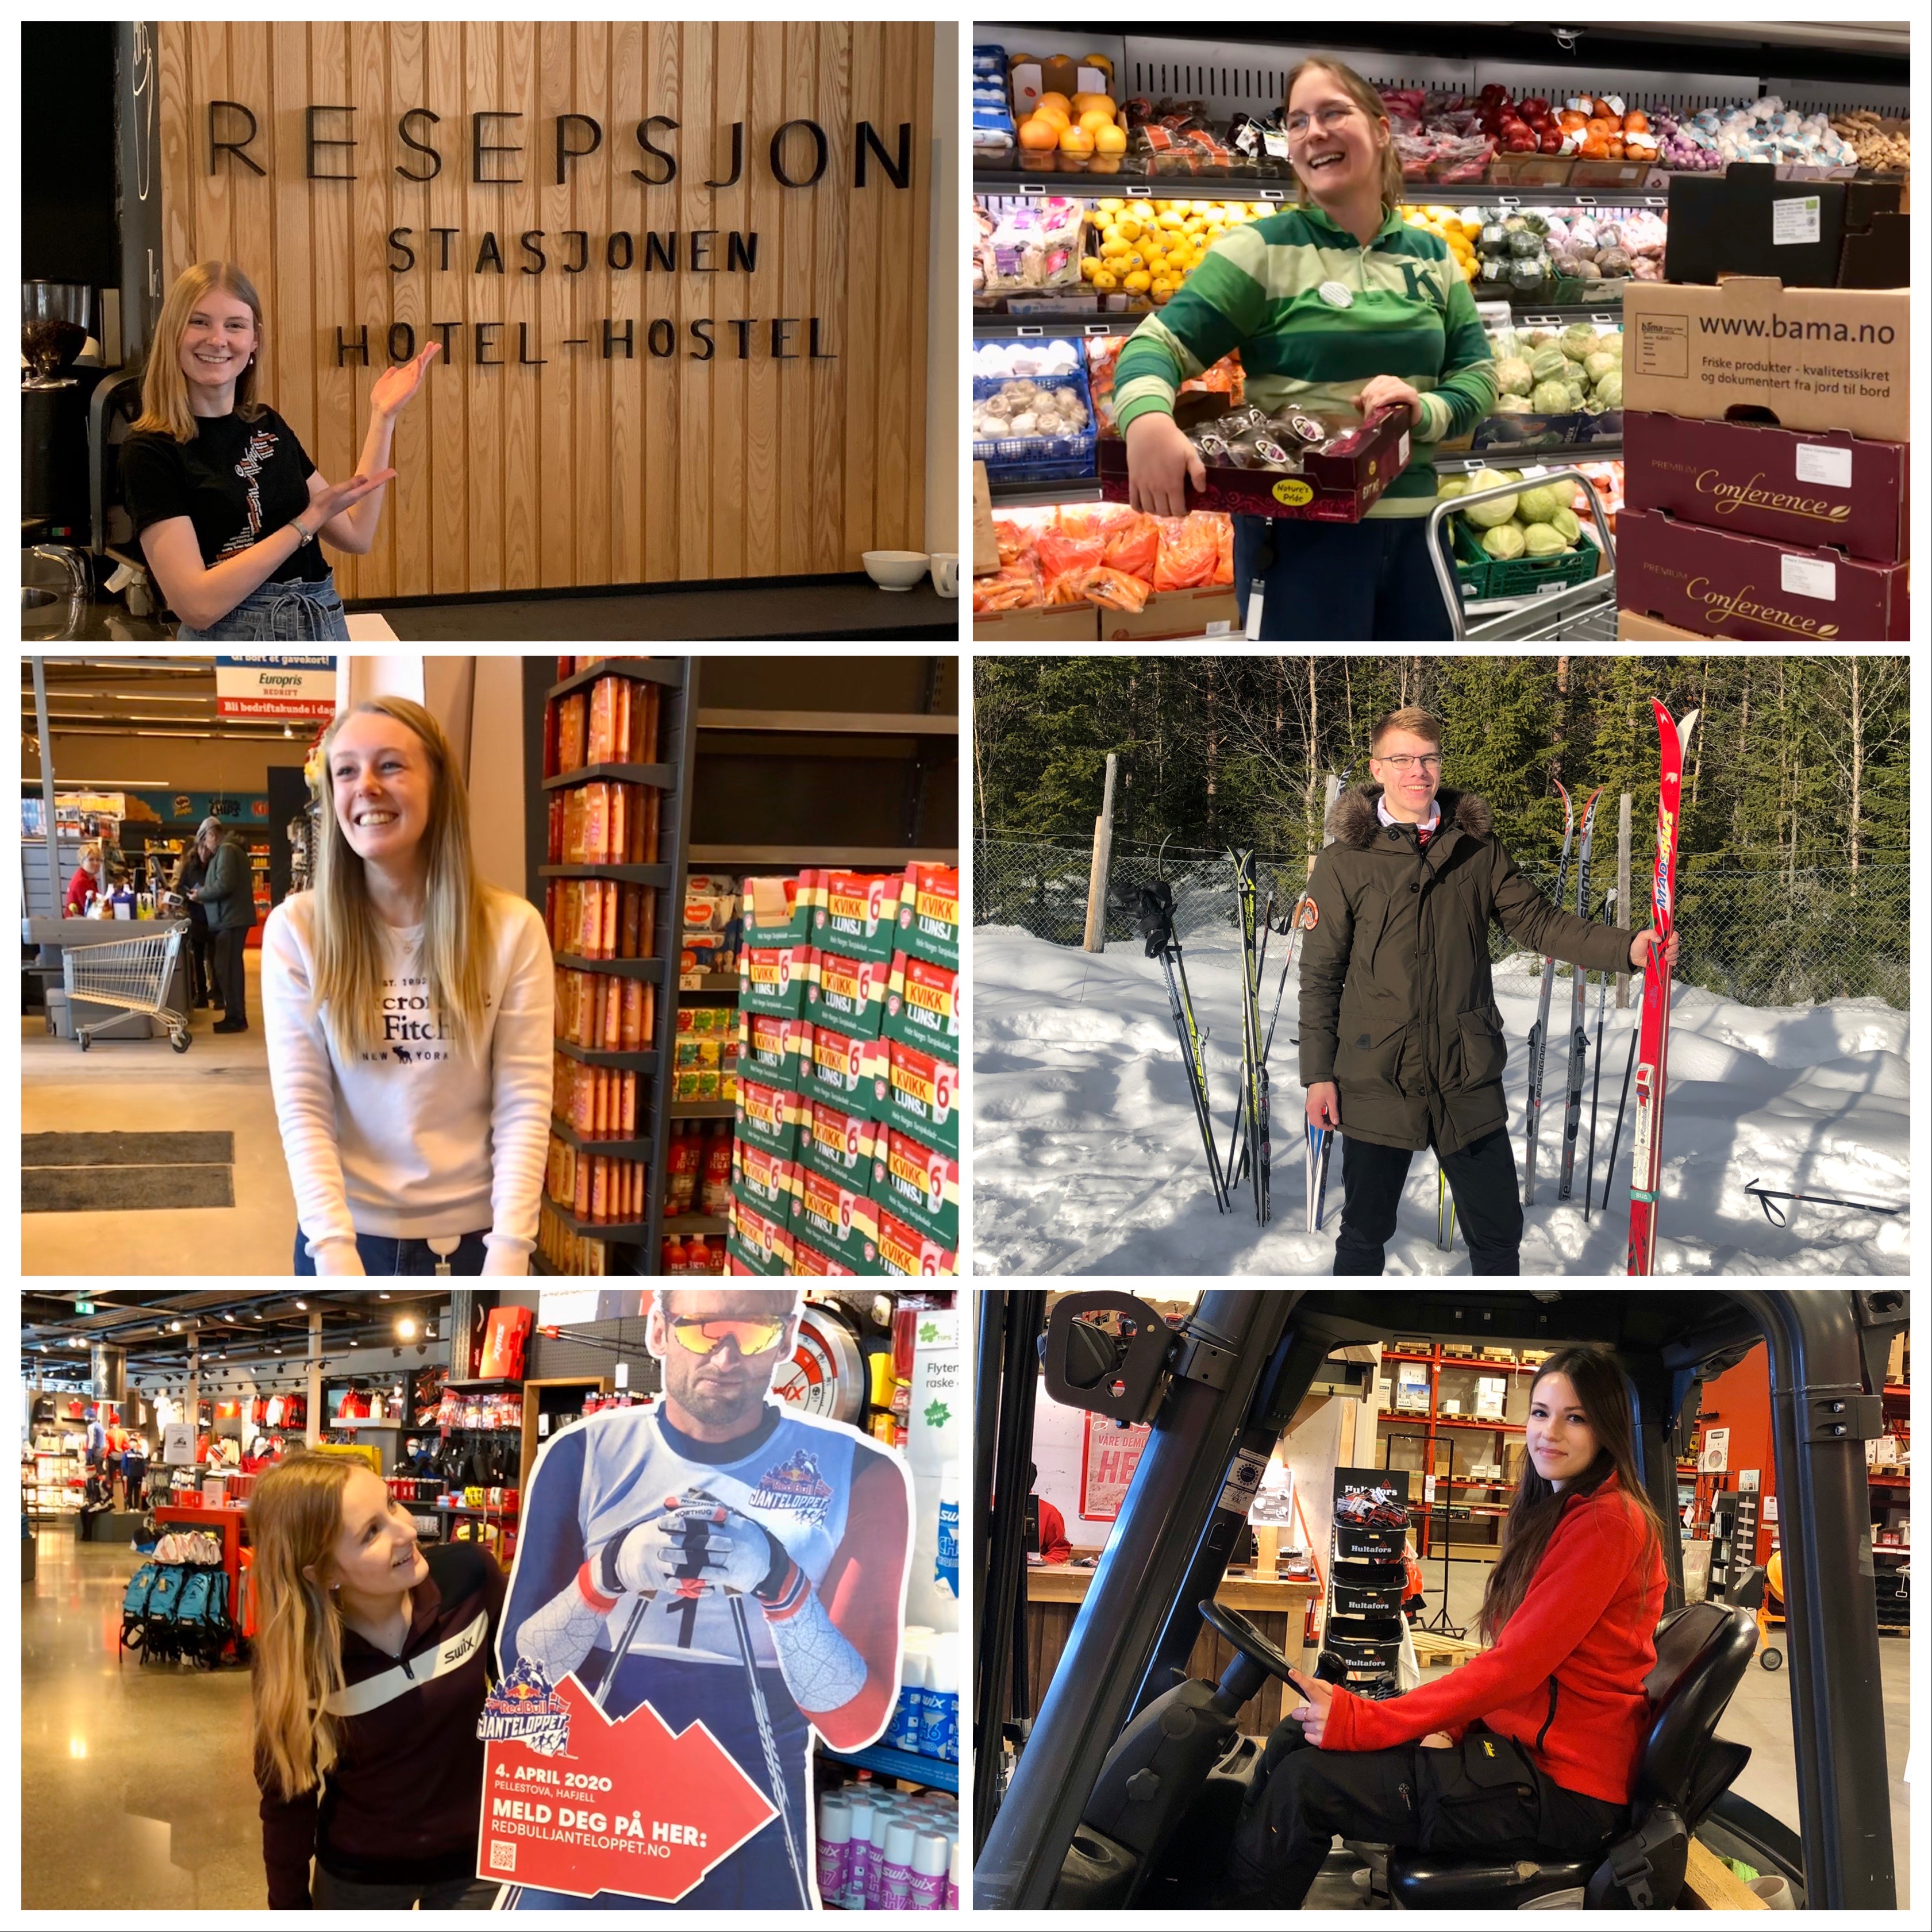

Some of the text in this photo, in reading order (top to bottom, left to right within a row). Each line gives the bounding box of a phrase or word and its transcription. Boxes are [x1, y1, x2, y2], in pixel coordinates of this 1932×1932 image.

[209, 101, 911, 189] RESEPSJON
[388, 227, 758, 275] STASJONEN
[1699, 313, 1895, 345] www.bama.no
[1702, 356, 1732, 370] Friske
[1735, 360, 1792, 375] produkter
[1803, 364, 1890, 382] kvalitetssikret
[1701, 373, 1890, 398] og dokumentert fra jord til bord
[1652, 459, 1697, 475] PREMIUM
[1276, 483, 1309, 493] Nature's
[1283, 493, 1304, 502] Pride
[1695, 469, 1829, 515] Conference
[1643, 562, 1688, 580] PREMIUM
[1686, 577, 1816, 632] Conference
[259, 673, 302, 687] Europris
[224, 701, 238, 711] Bli
[240, 702, 310, 714] bedriftskunde
[317, 705, 335, 716] dag
[1656, 809, 1673, 911] MADSHUS
[1554, 852, 1569, 910] SIGNOL
[1580, 859, 1591, 920] SIGNOL
[834, 898, 861, 917] KVIKK
[871, 889, 883, 921] 6
[922, 895, 954, 921] KVIKK
[832, 915, 861, 936] LUNSJ
[919, 915, 952, 941] LUNSJ
[1244, 896, 1252, 941] FISCHER
[781, 955, 789, 982] 6
[826, 973, 852, 995] KVIKK
[860, 969, 869, 1000] 6
[825, 991, 852, 1013] LUNSJ
[910, 984, 943, 1011] KVIKK
[382, 1013, 456, 1041] Fitch
[907, 1003, 942, 1032] LUNSJ
[362, 1051, 449, 1061] NEW YORK
[819, 1048, 842, 1071] KVIKK
[850, 1046, 860, 1076] 6
[817, 1065, 842, 1088] LUNSJ
[1536, 1042, 1546, 1098] ROSSIGNOL
[896, 1069, 926, 1099] KVIKK
[937, 1075, 949, 1109] 6
[894, 1088, 927, 1118] LUNSJ
[1251, 1072, 1260, 1125] FISCHER
[774, 1099, 783, 1125] 6
[815, 1124, 840, 1148] KVIKK
[846, 1126, 858, 1155] 6
[771, 1164, 779, 1189] 6
[892, 1155, 922, 1187] KVIKK
[930, 1165, 941, 1198] 6
[807, 1194, 833, 1219] KVIKK
[1636, 1192, 1648, 1200] BUA
[841, 1199, 850, 1227] 6
[765, 1226, 772, 1250] 6
[880, 1239, 912, 1273] KVIKK
[926, 1378, 954, 1388] raske
[1098, 1433, 1119, 1446] VÅRE
[749, 1488, 829, 1508] JANTELOPPET
[674, 1508, 713, 1518] NORTHUG
[1351, 1545, 1392, 1553] Hultafors
[1348, 1601, 1390, 1610] Hultafors
[666, 1596, 698, 1649] 1
[1345, 1658, 1386, 1668] Hultafors
[478, 1715, 569, 1740] JANTELOPPET
[495, 1763, 613, 1792] 4. APRIL 2020
[494, 1780, 596, 1803] PELLESTOVA, HAFJELL
[492, 1798, 707, 1848] MELD DEG PÅ HER:
[491, 1819, 671, 1858] REDBULLJANTELOPPET.NO
